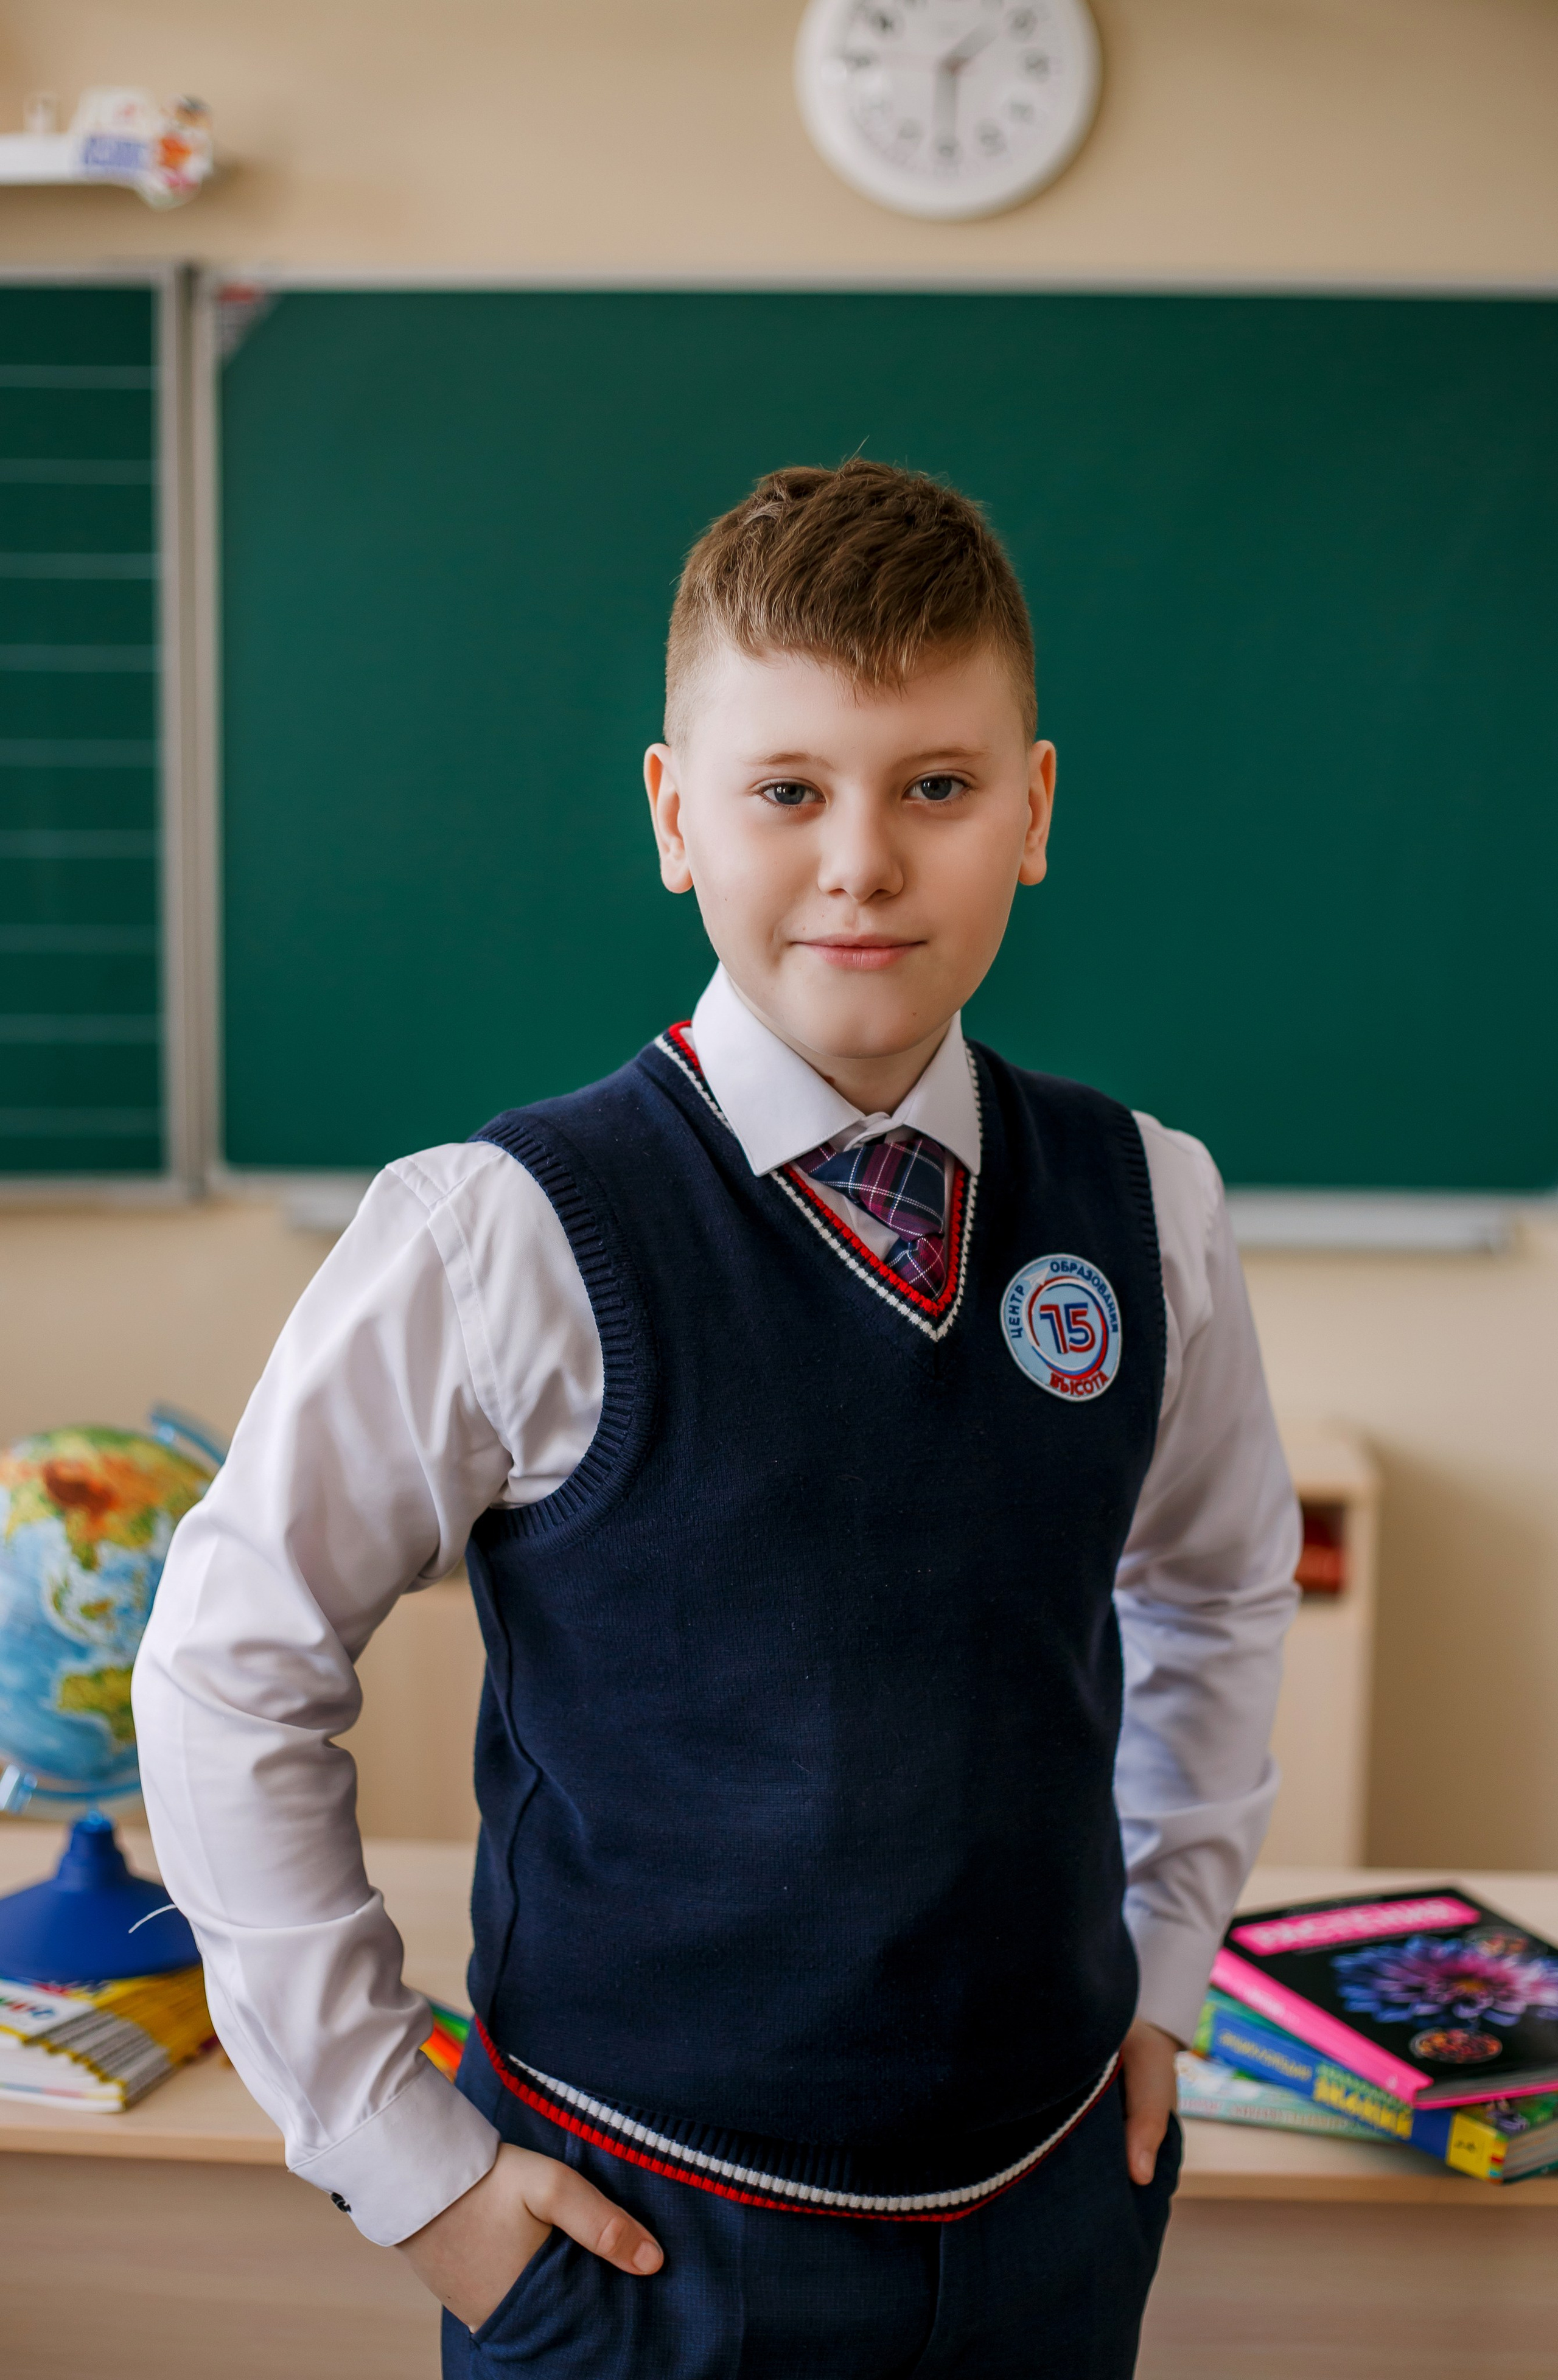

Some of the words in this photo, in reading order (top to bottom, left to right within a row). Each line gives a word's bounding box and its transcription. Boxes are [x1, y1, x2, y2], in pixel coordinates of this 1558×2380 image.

[1008, 1285, 1025, 1338] ЦЕНТР
[1039, 1302, 1096, 1355] 15
[1049, 1370, 1109, 1395] ВЫСОТА
